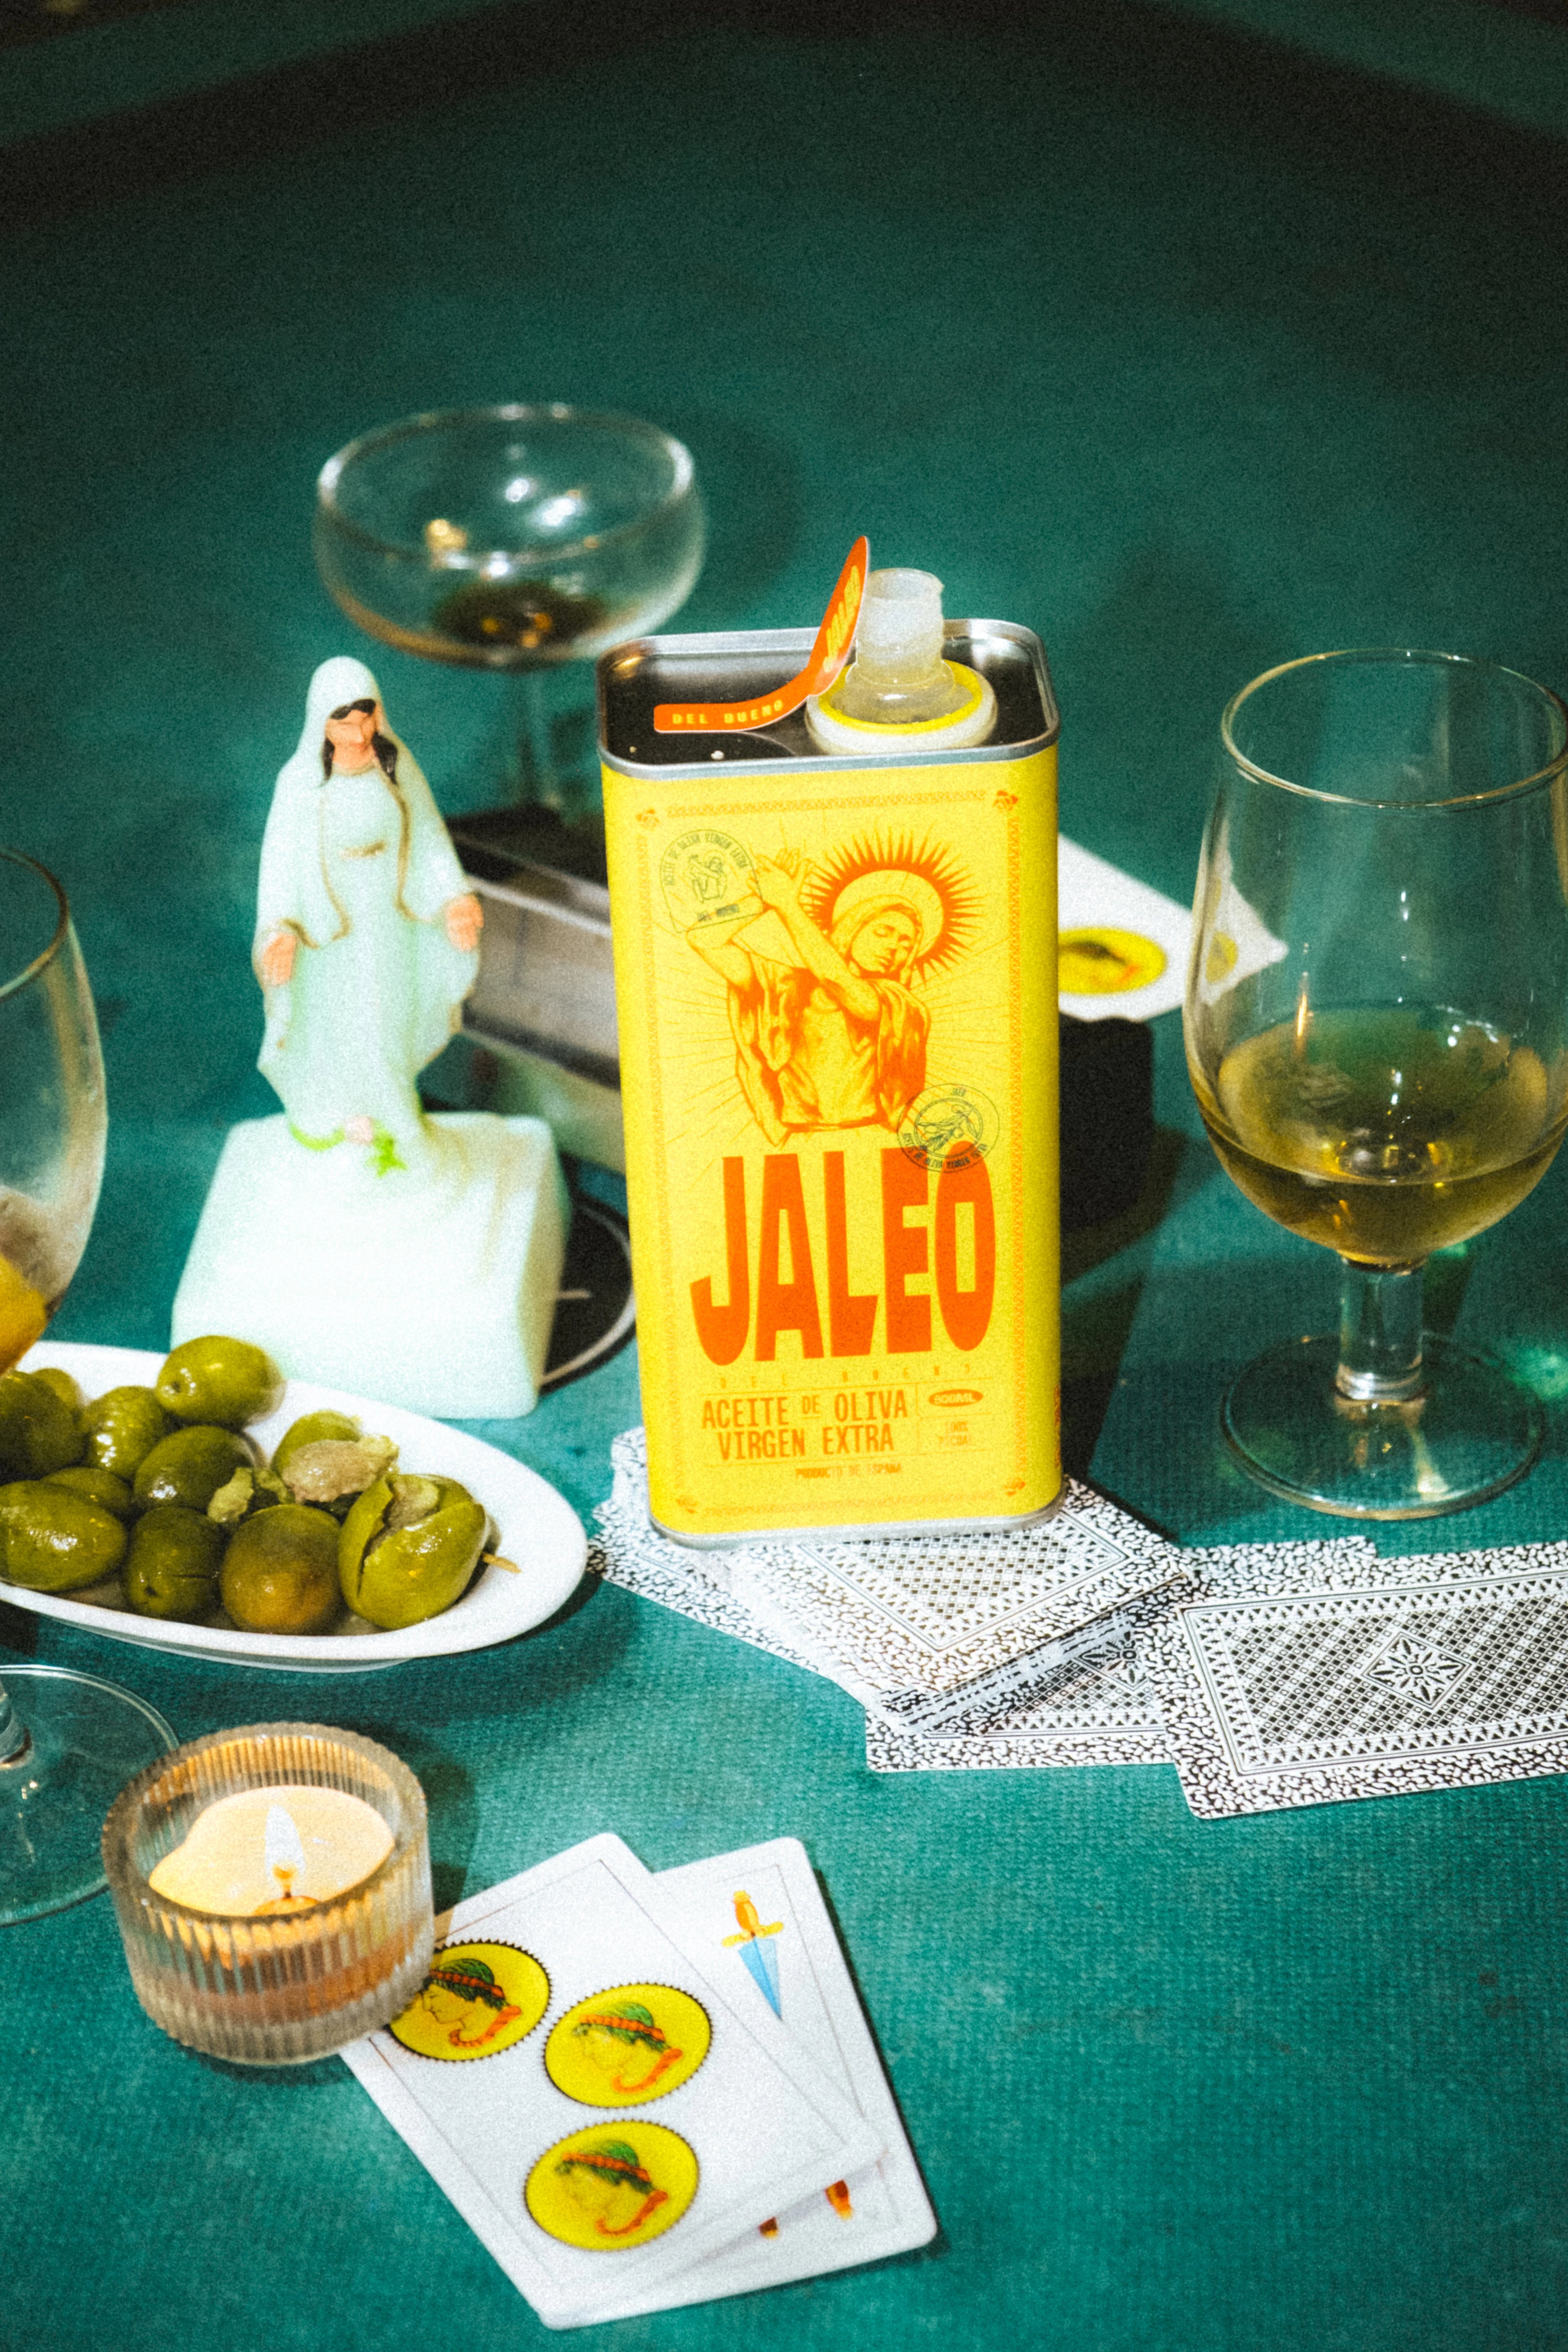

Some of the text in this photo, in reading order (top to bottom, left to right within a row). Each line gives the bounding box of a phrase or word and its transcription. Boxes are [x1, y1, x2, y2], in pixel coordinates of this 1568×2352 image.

[672, 699, 784, 724] DEL BUENO
[689, 1141, 996, 1366] JALEO
[701, 1390, 908, 1429] ACEITE DE OLIVA
[934, 1393, 976, 1405] 500ML
[717, 1422, 894, 1461] VIRGEN EXTRA
[795, 1465, 842, 1479] PRODUCTO
